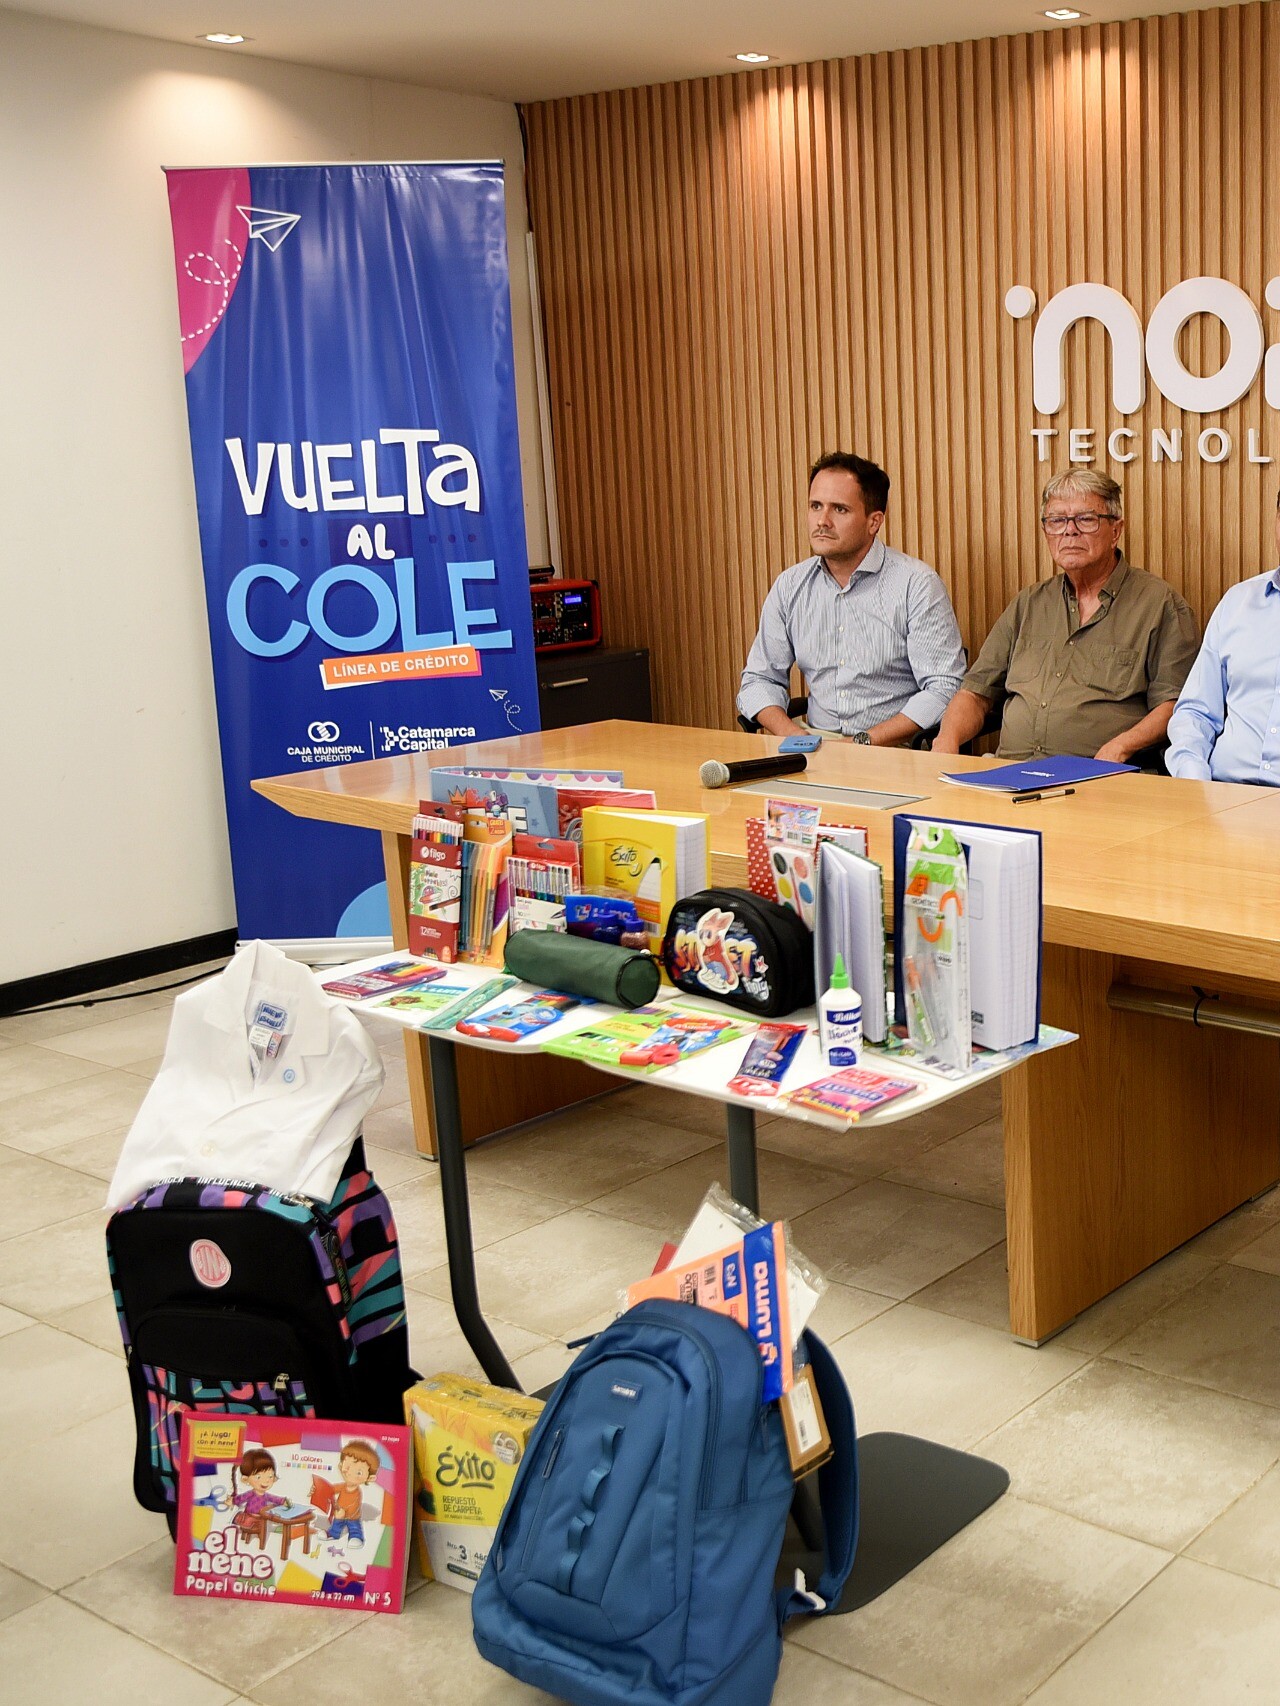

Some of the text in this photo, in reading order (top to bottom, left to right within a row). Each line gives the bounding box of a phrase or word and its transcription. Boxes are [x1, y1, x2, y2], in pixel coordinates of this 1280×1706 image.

[346, 523, 396, 560] AL
[226, 557, 513, 657] COLE
[333, 654, 469, 678] LÍNEA DE CRÉDITO
[398, 726, 477, 739] Catamarca
[287, 745, 365, 755] CAJA MUNICIPAL
[398, 737, 450, 752] Capital
[301, 753, 352, 763] DE CRÉDITO
[429, 847, 446, 861] filgo
[300, 1455, 323, 1463] colores
[436, 1445, 495, 1487] Éxito
[442, 1495, 476, 1506] REPUESTO
[443, 1504, 482, 1515] DE CARPETA
[204, 1527, 237, 1555] el
[459, 1544, 467, 1560] 3
[187, 1551, 272, 1578] nene
[187, 1575, 276, 1596] Papel afiche
[384, 1591, 391, 1606] 5
